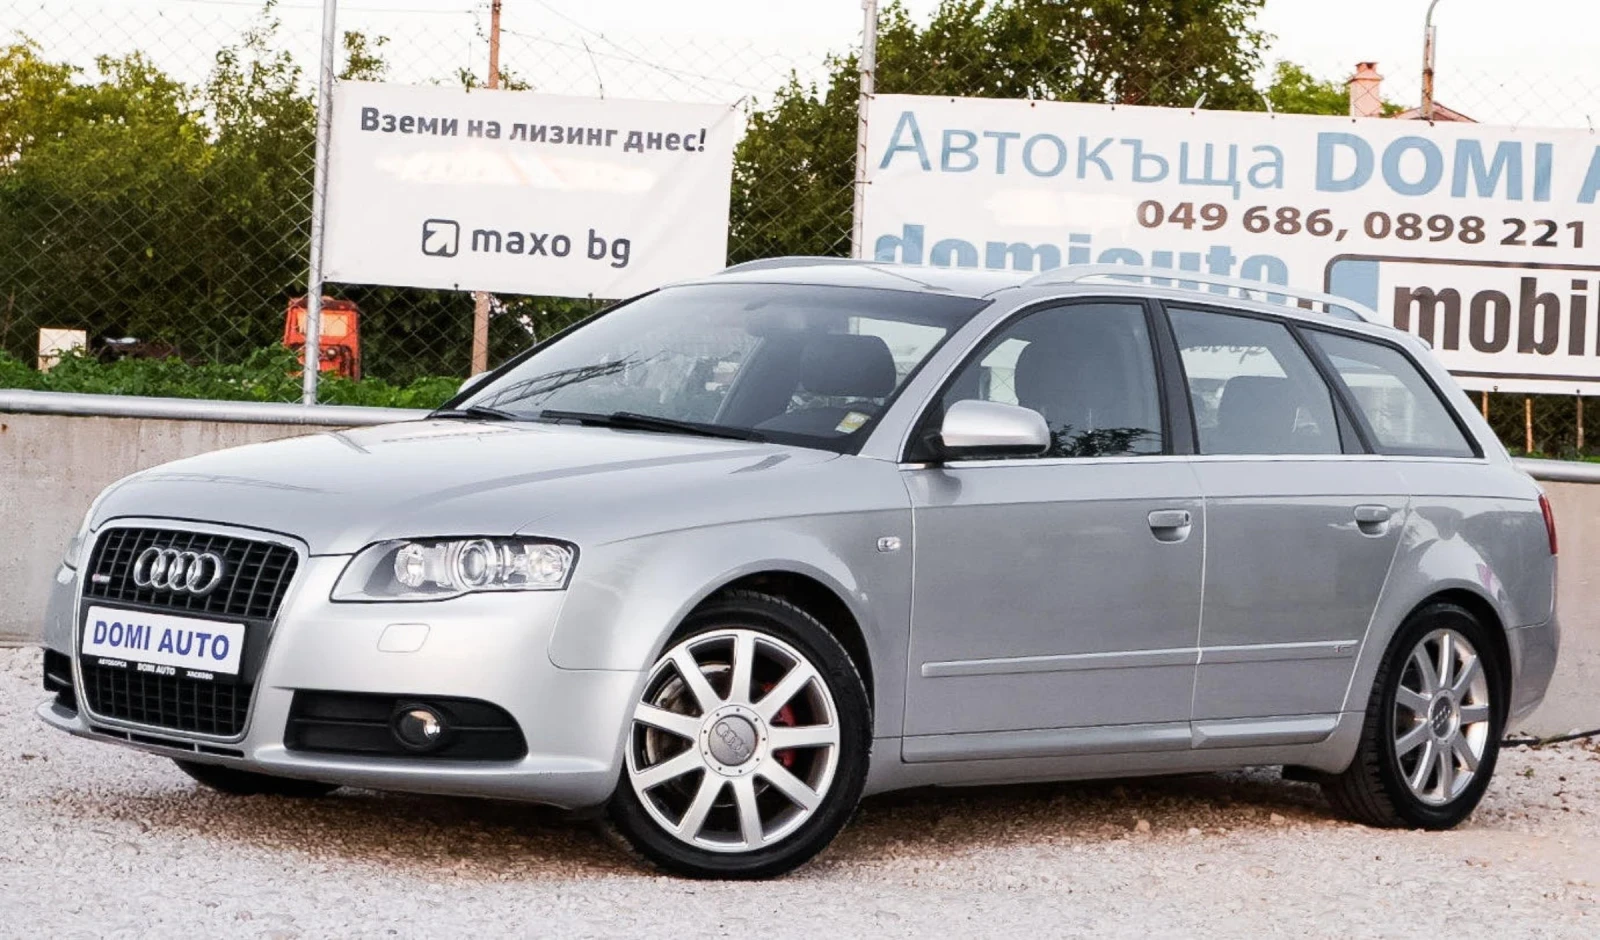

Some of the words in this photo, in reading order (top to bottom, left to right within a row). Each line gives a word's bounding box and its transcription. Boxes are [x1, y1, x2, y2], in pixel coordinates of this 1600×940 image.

[360, 106, 459, 137] Вземи
[467, 120, 502, 140] на
[509, 122, 619, 147] лизинг
[623, 128, 707, 153] днес!
[878, 110, 1285, 201] Автокъща
[1314, 131, 1554, 203] DOMI
[1136, 199, 1229, 232] 049
[1241, 205, 1349, 243] 686,
[1363, 210, 1487, 245] 0898
[1499, 217, 1585, 249] 221
[471, 228, 572, 258] maxo
[586, 228, 632, 269] bg
[1392, 276, 1600, 358] mobi
[92, 620, 151, 651] DOMI
[157, 628, 230, 661] AUTO
[155, 664, 176, 676] AUTO
